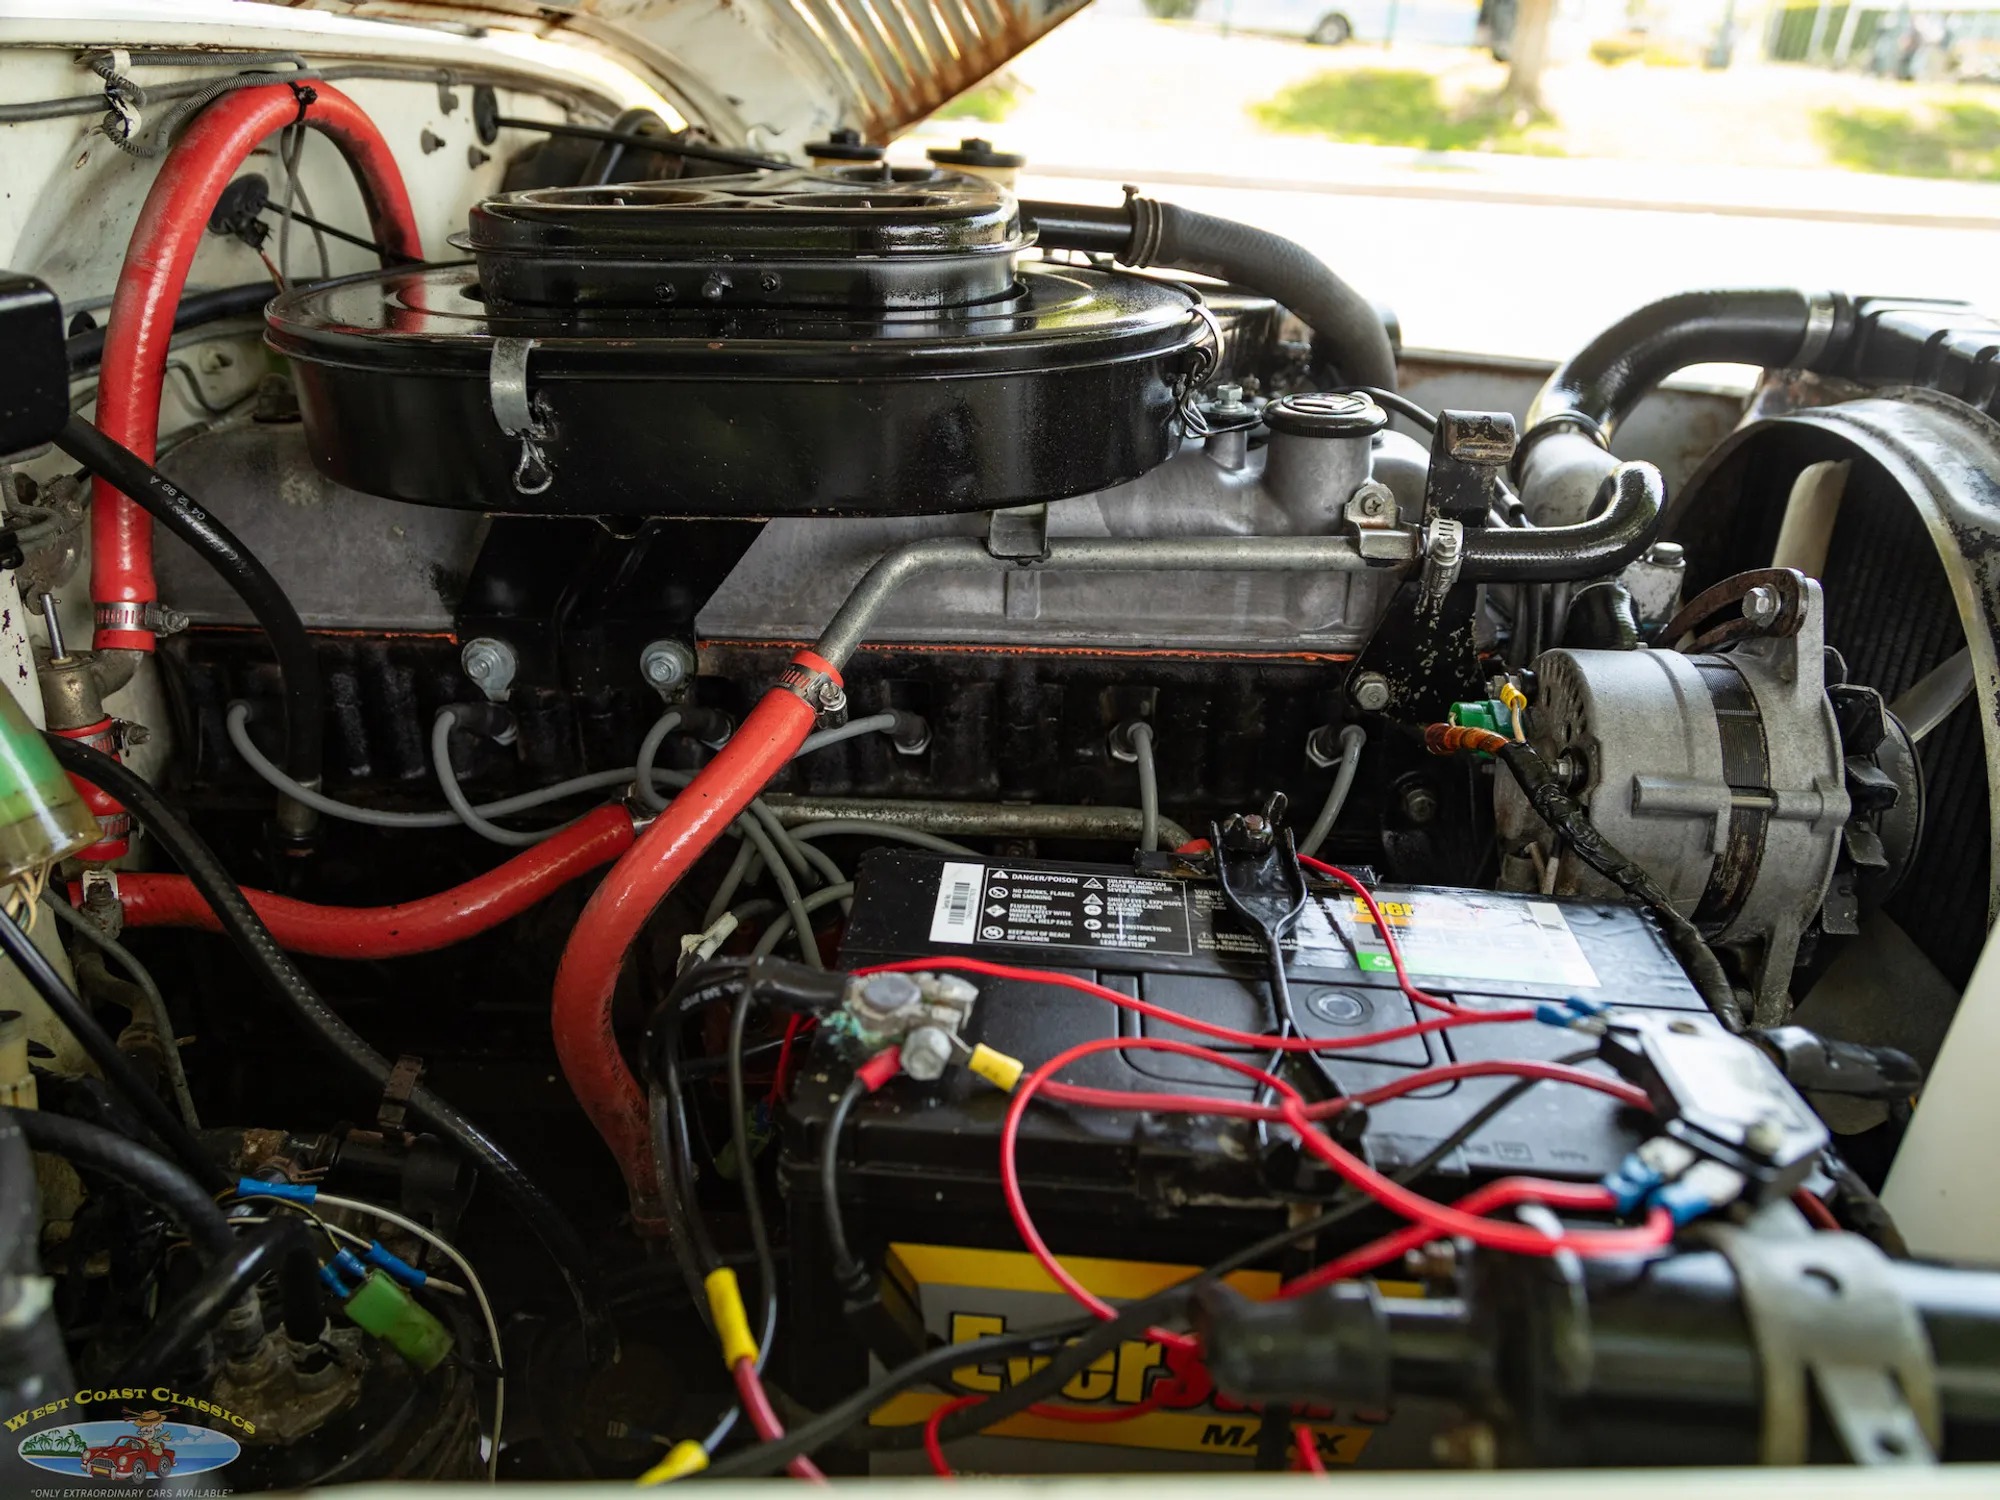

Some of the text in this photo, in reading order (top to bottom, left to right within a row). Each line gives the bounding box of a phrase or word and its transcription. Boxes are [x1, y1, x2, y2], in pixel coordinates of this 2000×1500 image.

[191, 507, 206, 520] 04
[1012, 874, 1078, 883] DANGER/POISON
[1128, 884, 1163, 892] BLINDNESS
[1050, 890, 1075, 898] FLAMES
[1148, 899, 1182, 907] EXPLOSIVE
[1125, 924, 1172, 933] INSTRUCTIONS
[1137, 935, 1156, 943] OPEN
[1118, 940, 1148, 948] BATTERY
